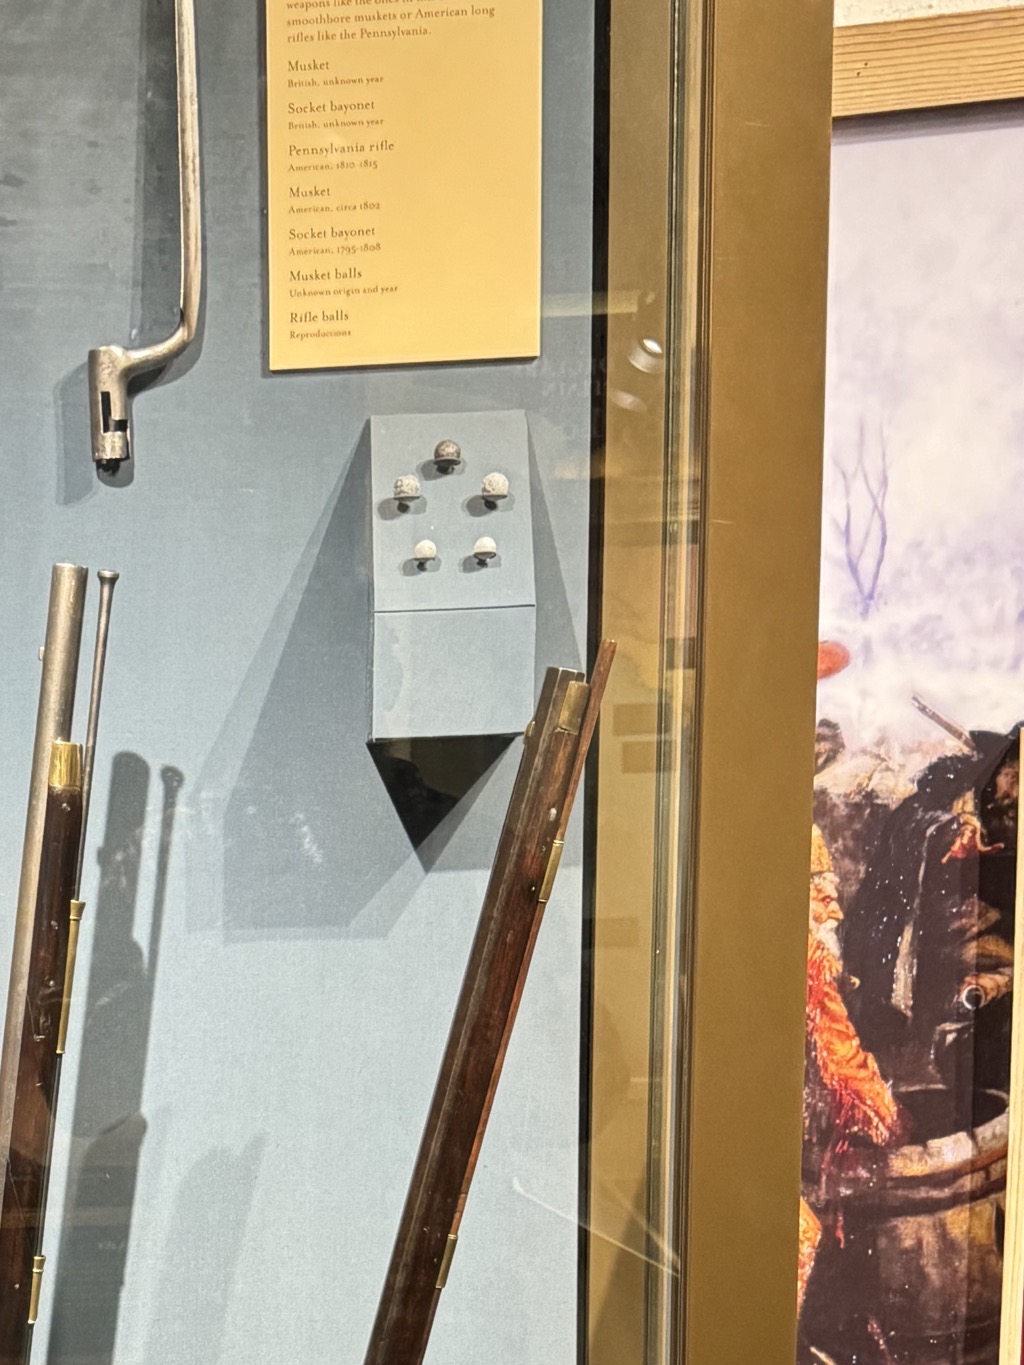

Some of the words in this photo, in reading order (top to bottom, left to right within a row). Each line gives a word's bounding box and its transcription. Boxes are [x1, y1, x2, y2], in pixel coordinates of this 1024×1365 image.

[286, 12, 351, 27] smoothbore
[354, 11, 397, 24] muskets
[400, 12, 413, 20] or
[415, 8, 468, 20] American
[471, 5, 496, 18] long
[287, 31, 314, 44] rifles
[317, 30, 337, 42] like
[340, 28, 356, 40] the
[360, 26, 432, 40] Pennsylvania.
[288, 60, 330, 72] Musket
[288, 78, 320, 88] British,
[323, 76, 364, 86] unknown
[366, 76, 384, 86] year
[288, 102, 326, 115] Socket
[330, 100, 375, 115] bayonet
[288, 120, 320, 130] British,
[323, 118, 364, 129] unknown
[366, 118, 384, 128] year
[288, 142, 366, 158] Pennsylvania
[369, 140, 394, 152] rifle
[288, 163, 334, 173] American,
[289, 186, 330, 198] Musket
[288, 205, 334, 215] American,
[336, 204, 357, 212] circa
[359, 202, 380, 211] 1802
[288, 228, 326, 240] Socket
[330, 226, 376, 241] bayonet
[288, 247, 334, 256] American,
[290, 270, 330, 282] Musket
[334, 268, 362, 280] balls
[289, 288, 331, 298] Unknown
[333, 287, 360, 297] origin
[362, 286, 378, 294] and
[380, 286, 398, 295] year
[290, 312, 318, 324] Rifle
[322, 310, 349, 322] balls
[290, 330, 352, 341] Reproductions
